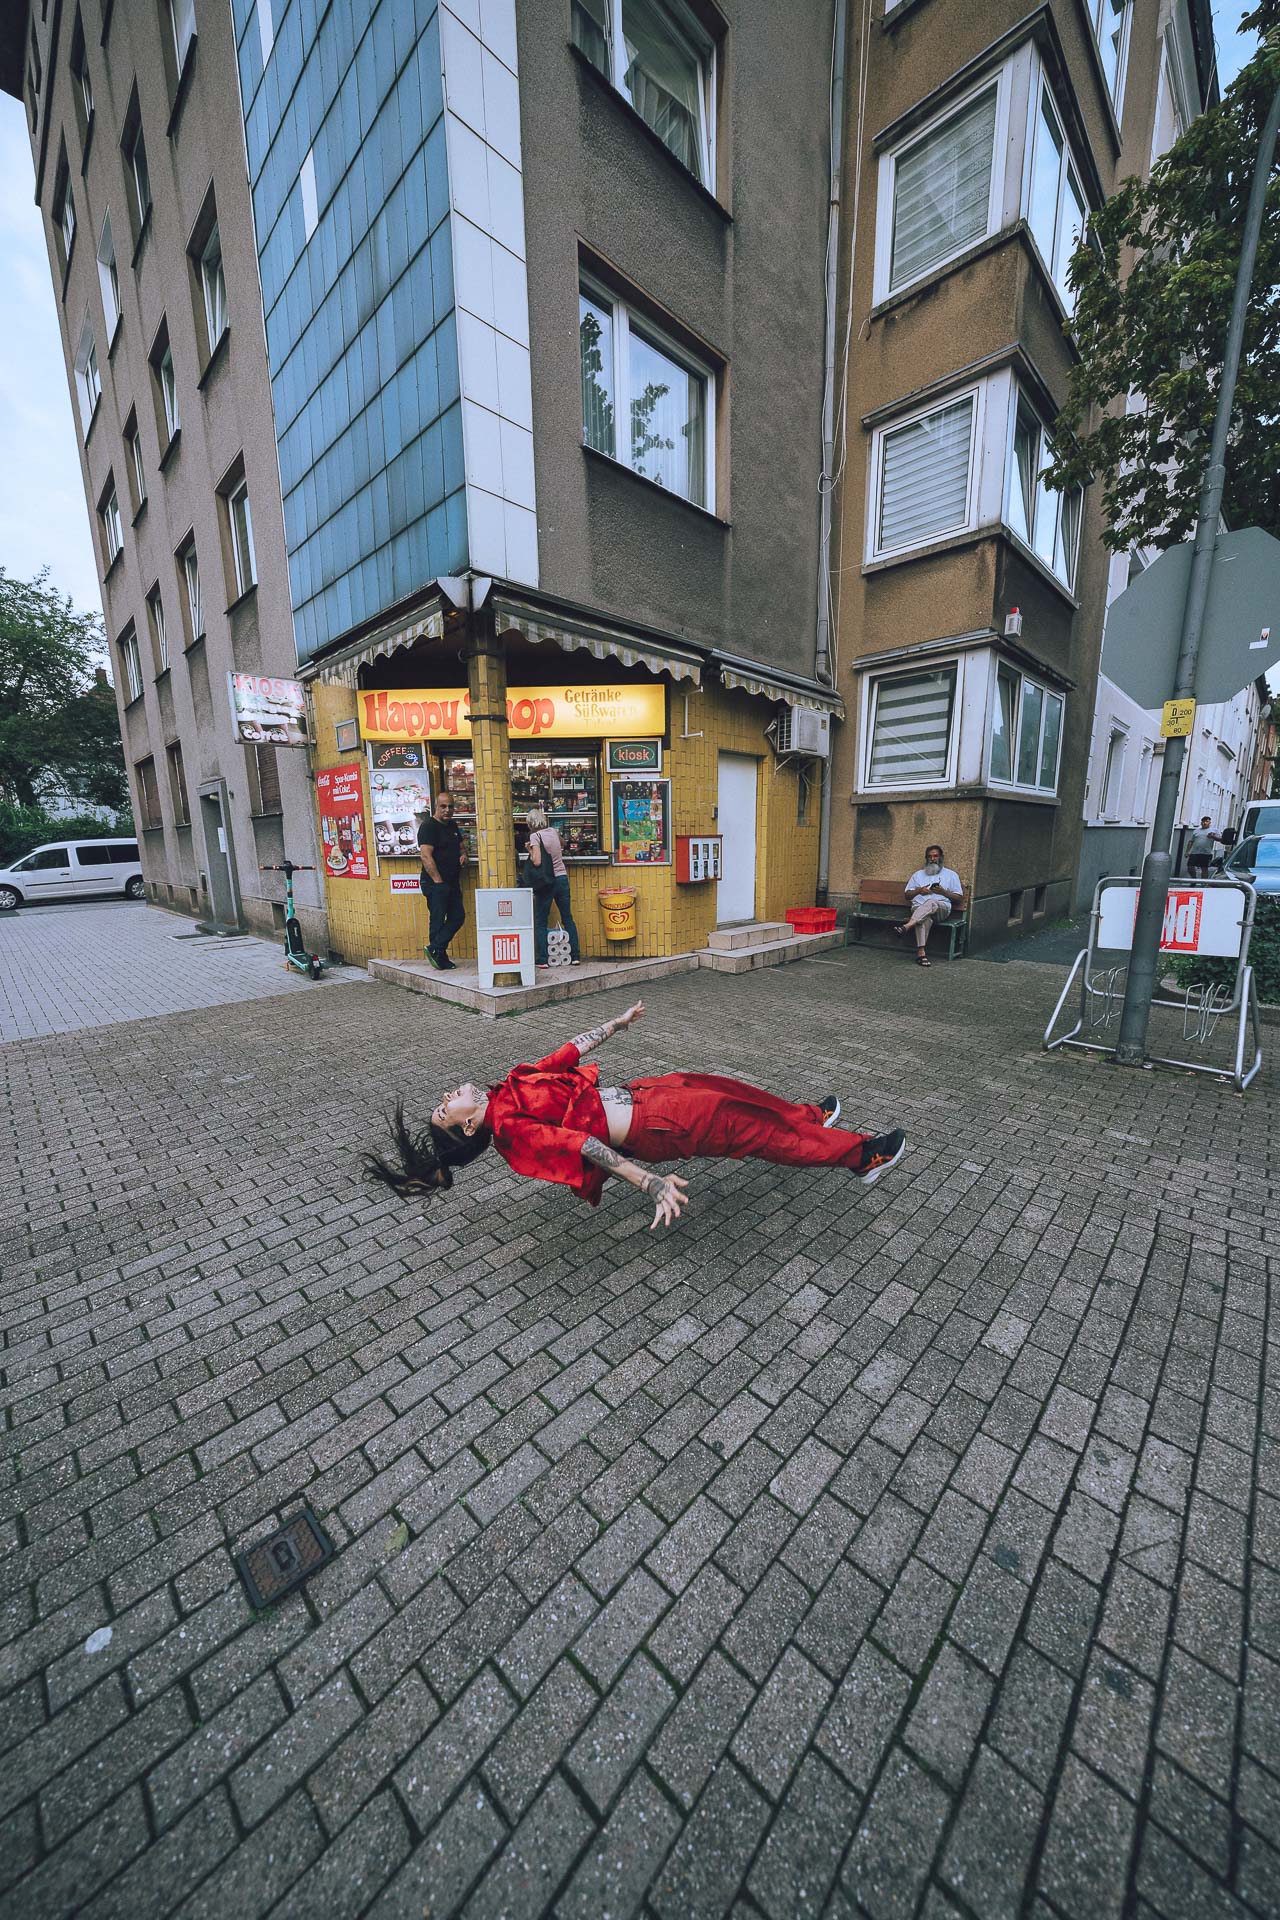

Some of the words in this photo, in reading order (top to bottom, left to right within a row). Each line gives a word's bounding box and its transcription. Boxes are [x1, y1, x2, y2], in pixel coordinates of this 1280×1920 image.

[235, 674, 300, 698] KIOSK
[564, 689, 622, 703] Getränke
[363, 691, 460, 737] Happy
[575, 703, 637, 718] Süßwarn
[377, 746, 408, 767] COFFEE
[618, 749, 650, 761] kiosk
[378, 843, 391, 853] to
[393, 845, 408, 854] go
[1161, 896, 1198, 943] ld
[494, 937, 518, 961] Bild
